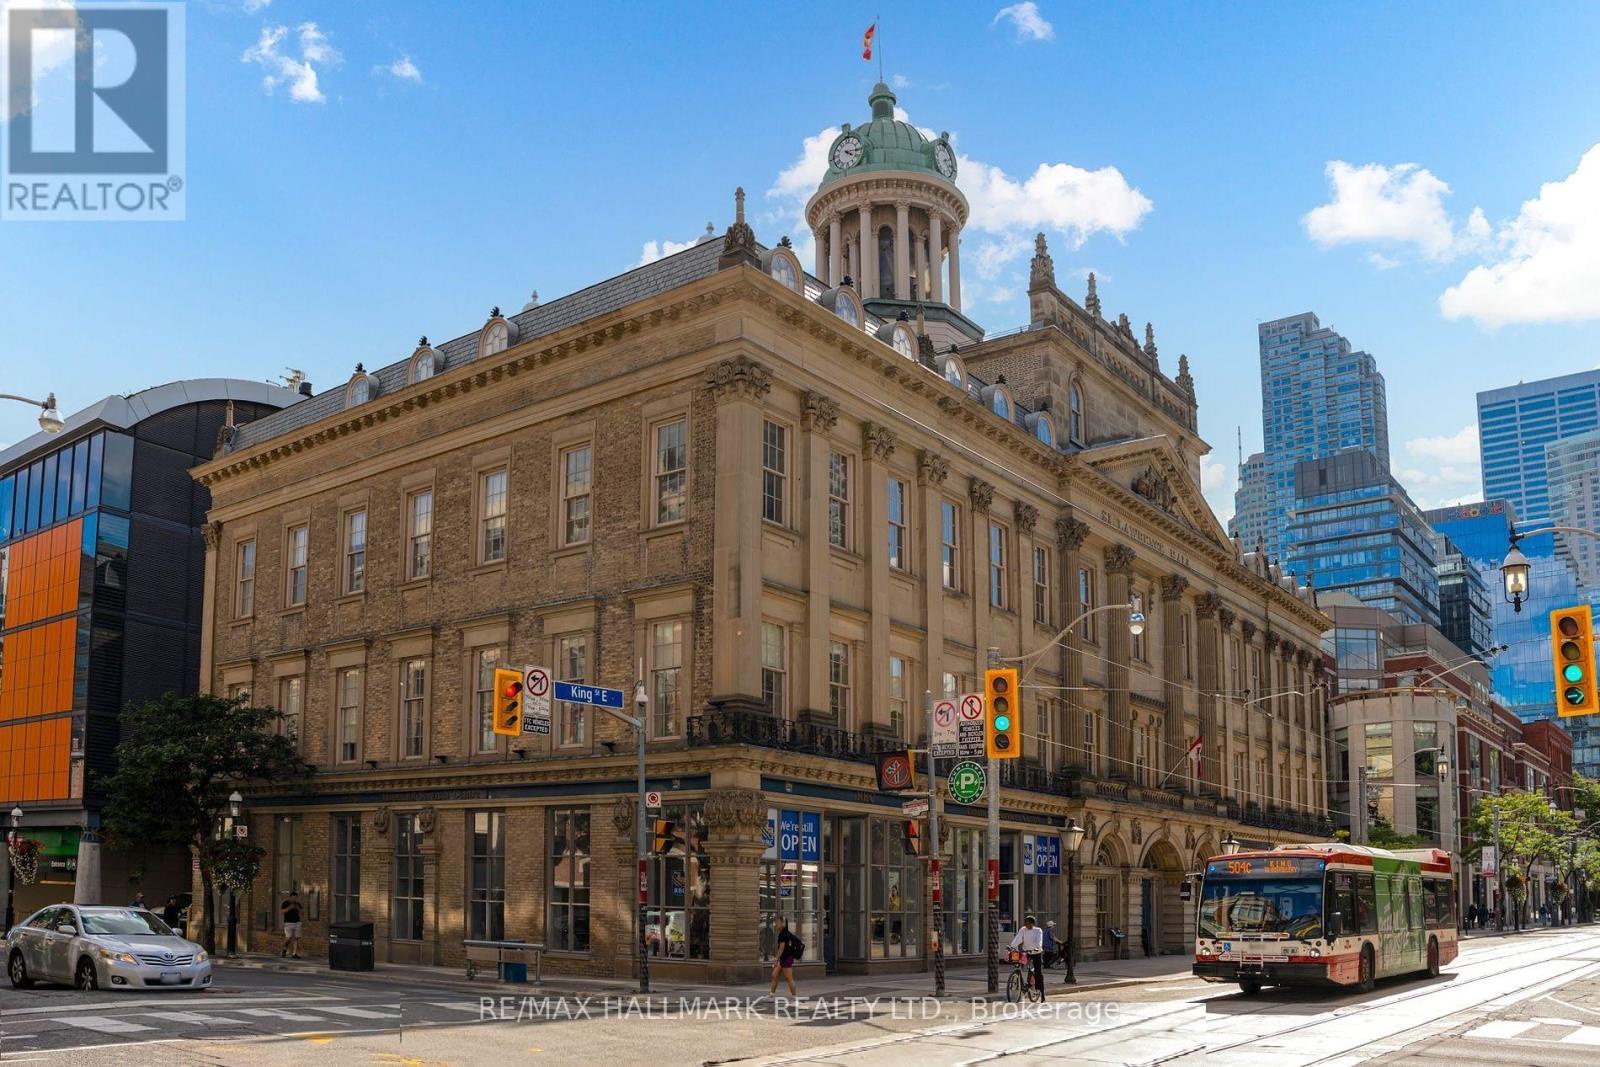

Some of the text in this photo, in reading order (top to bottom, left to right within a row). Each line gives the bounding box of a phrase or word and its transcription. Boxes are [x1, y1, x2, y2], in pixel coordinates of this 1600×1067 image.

[571, 686, 593, 703] King
[601, 691, 608, 702] E
[960, 773, 975, 790] P
[781, 833, 817, 853] OPEN
[1036, 854, 1058, 868] OPEN
